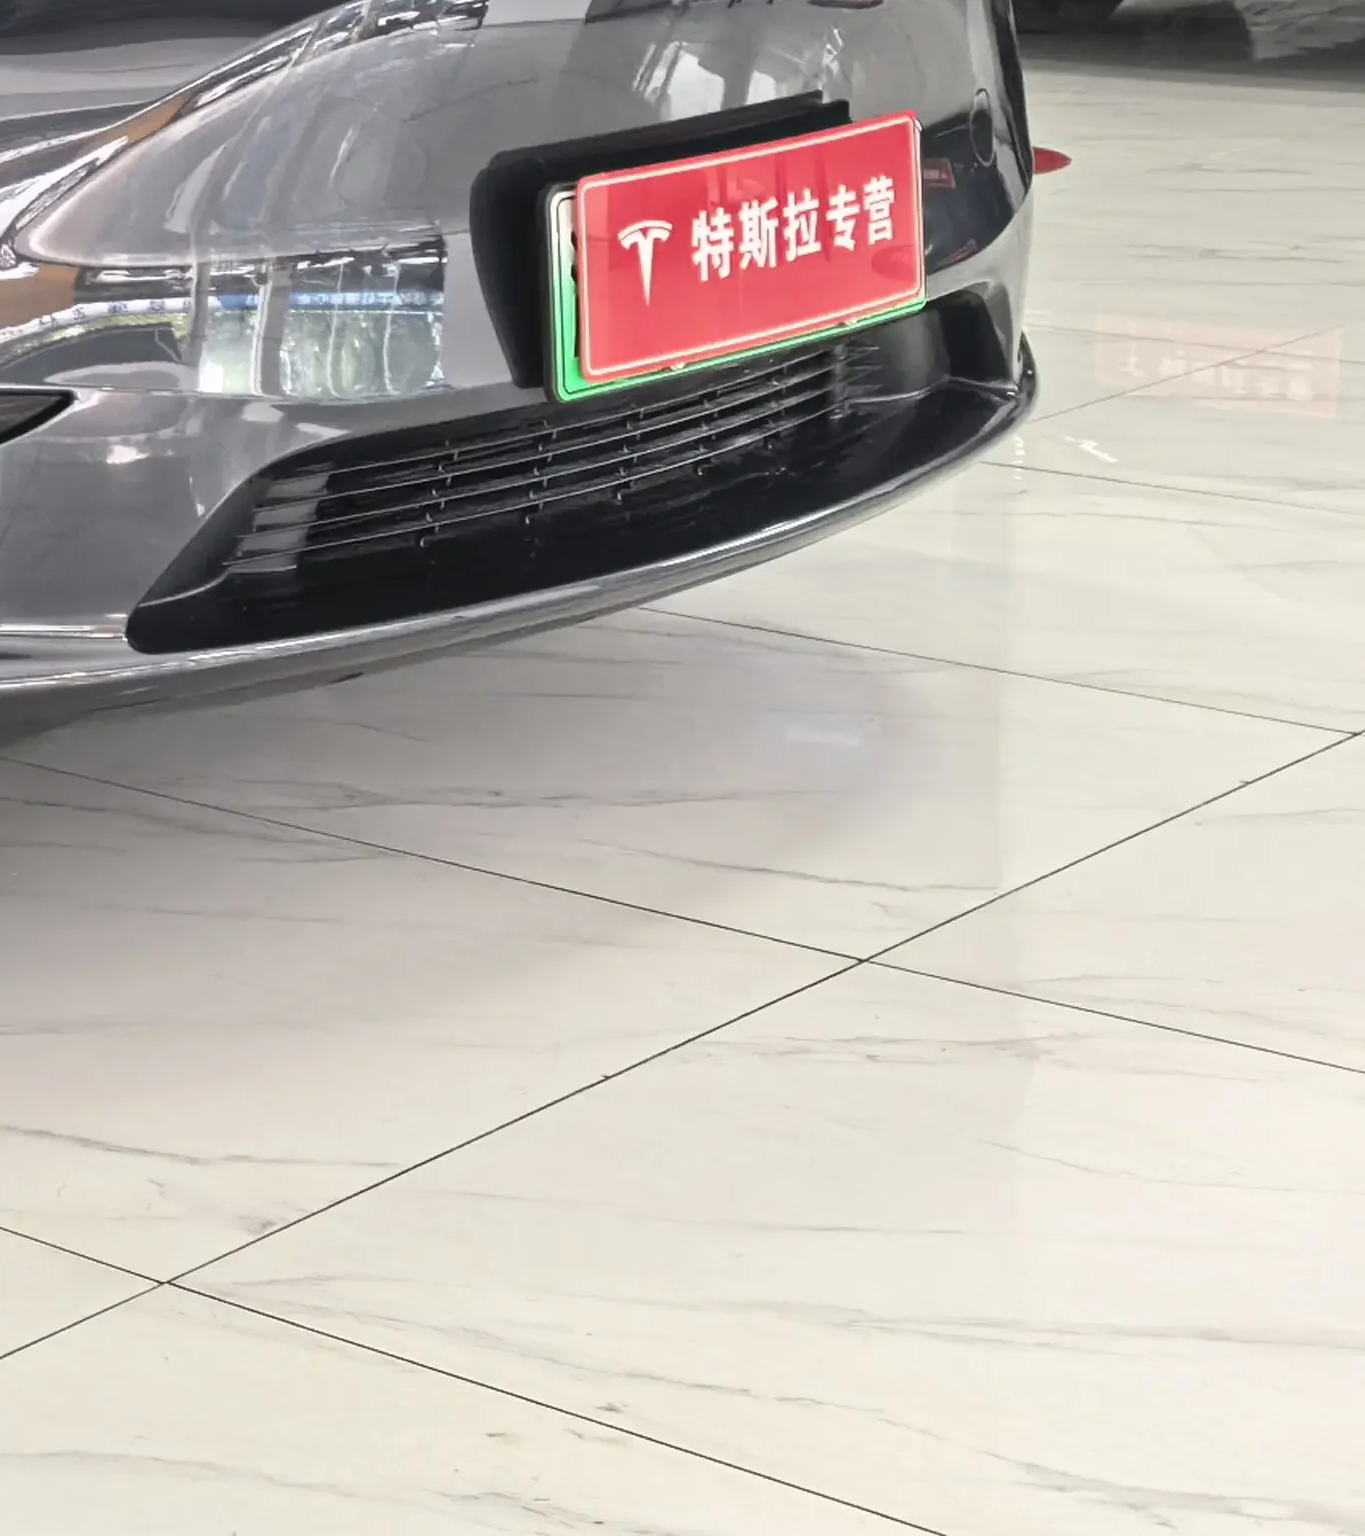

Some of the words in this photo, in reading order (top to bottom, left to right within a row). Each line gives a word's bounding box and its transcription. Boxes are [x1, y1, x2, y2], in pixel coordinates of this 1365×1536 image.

[689, 174, 898, 283] 特斯拉专营
